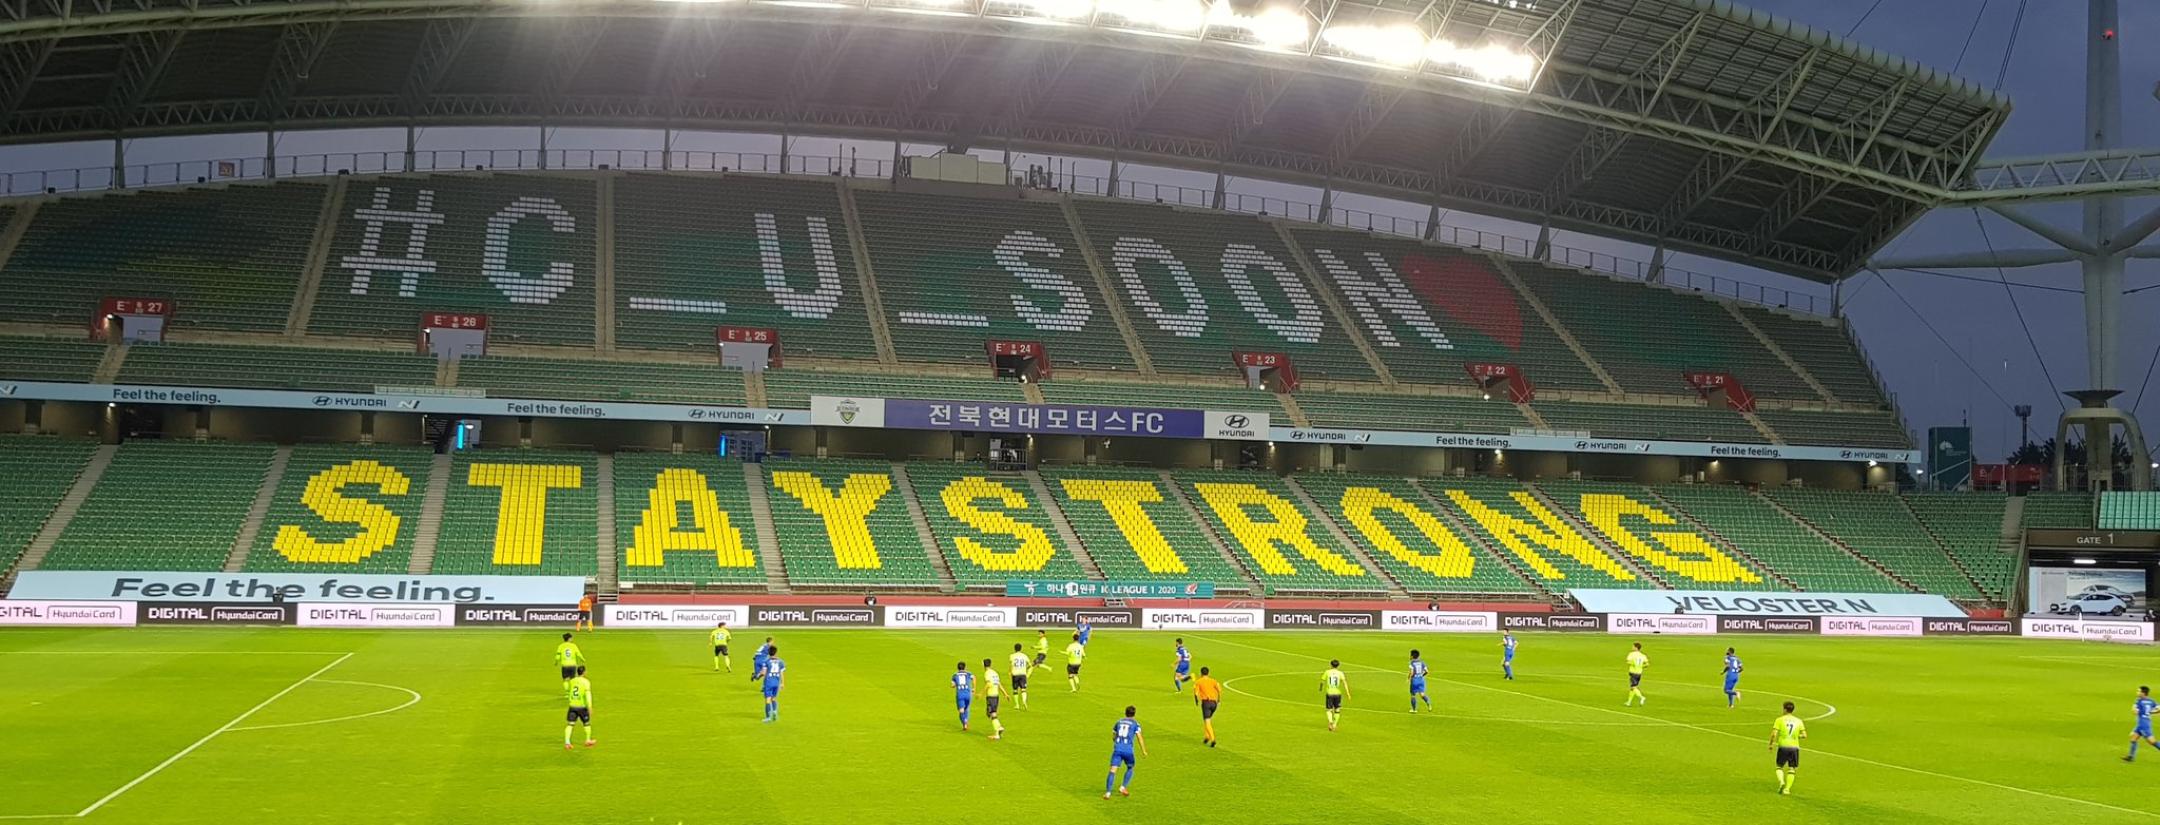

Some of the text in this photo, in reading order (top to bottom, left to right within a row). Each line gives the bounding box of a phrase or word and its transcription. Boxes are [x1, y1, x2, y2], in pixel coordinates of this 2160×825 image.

[147, 302, 162, 312] 27
[463, 317, 476, 327] 26
[754, 331, 767, 341] 25
[1020, 344, 1031, 353] 24
[1264, 355, 1276, 364] 23
[1495, 366, 1505, 375] 22
[1715, 375, 1724, 384] 21
[113, 388, 221, 404] Feel the feeling.
[335, 397, 387, 407] HYUNDAI
[507, 403, 606, 417] Feel the feeling.
[708, 411, 755, 420] HYUNDAI
[1219, 429, 1255, 438] HYUNDAI
[1307, 432, 1346, 440] HYUNDAI
[1436, 436, 1511, 448] Feel the feeling.
[1590, 442, 1627, 450] HYUNDAI
[1711, 445, 1781, 458] Feel the feeling.
[1854, 451, 1888, 459] HYUNDAI
[2077, 533, 2114, 545] GATE 1
[111, 578, 495, 603] Feel the feeling.
[1112, 585, 1148, 594] LEAGUE
[1158, 586, 1176, 594] 2020
[1666, 596, 1878, 613] VELOSTER N
[148, 607, 208, 619] DIGITAL
[310, 609, 367, 620] DIGITAL
[465, 610, 521, 621] DIGITAL
[616, 610, 669, 621] DIGITAL
[758, 611, 810, 621] DIGITAL
[895, 611, 943, 622] DIGITAL
[1026, 612, 1072, 622] DIGITAL
[1152, 613, 1197, 623] DIGITAL
[1273, 614, 1316, 625] DIGITAL
[1391, 615, 1432, 625] DIGITAL
[1505, 617, 1546, 627] DIGITAL
[1617, 618, 1656, 628] DIGITAL
[1724, 619, 1763, 629] DIGITAL
[1829, 621, 1866, 630] DIGITAL
[1929, 622, 1966, 631] DIGITAL
[2032, 623, 2079, 634] DIGITAL
